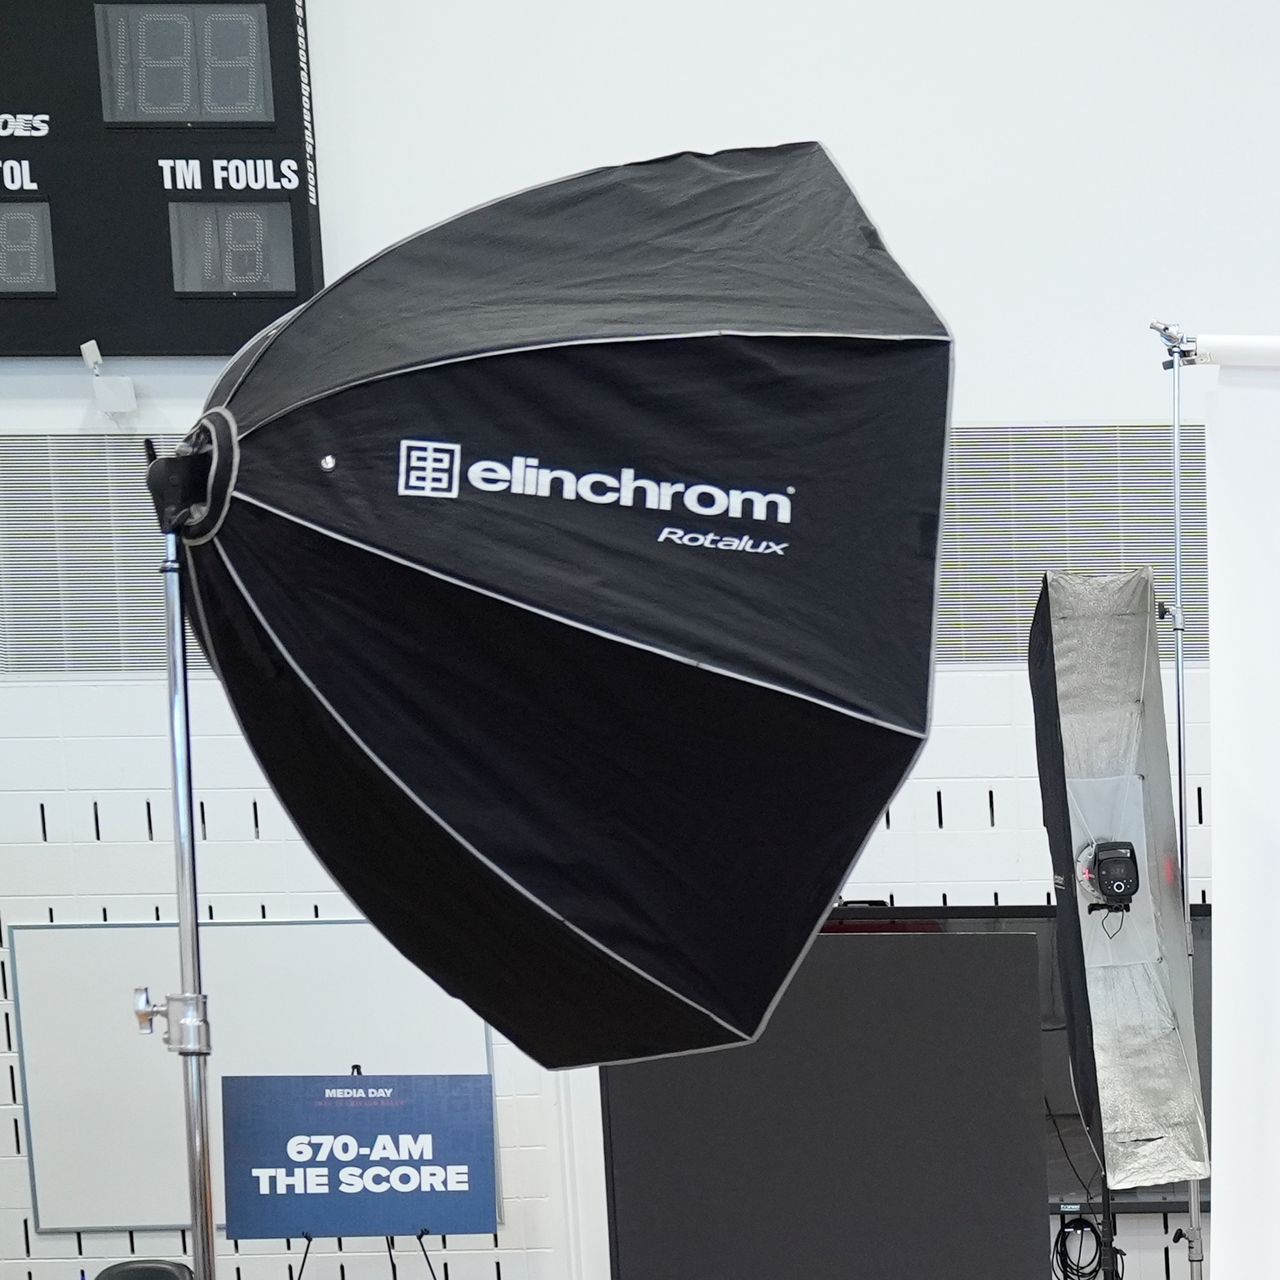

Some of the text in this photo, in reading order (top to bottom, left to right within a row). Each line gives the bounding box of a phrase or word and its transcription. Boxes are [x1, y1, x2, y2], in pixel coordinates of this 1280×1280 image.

[0, 159, 39, 191] OL
[157, 158, 299, 190] TM FOULS
[467, 455, 793, 524] elinchrom
[657, 526, 790, 556] Rotalux
[325, 1088, 394, 1098] MEDIA DAY
[286, 1133, 433, 1162] 670-AM
[251, 1164, 469, 1195] THE SCORE
